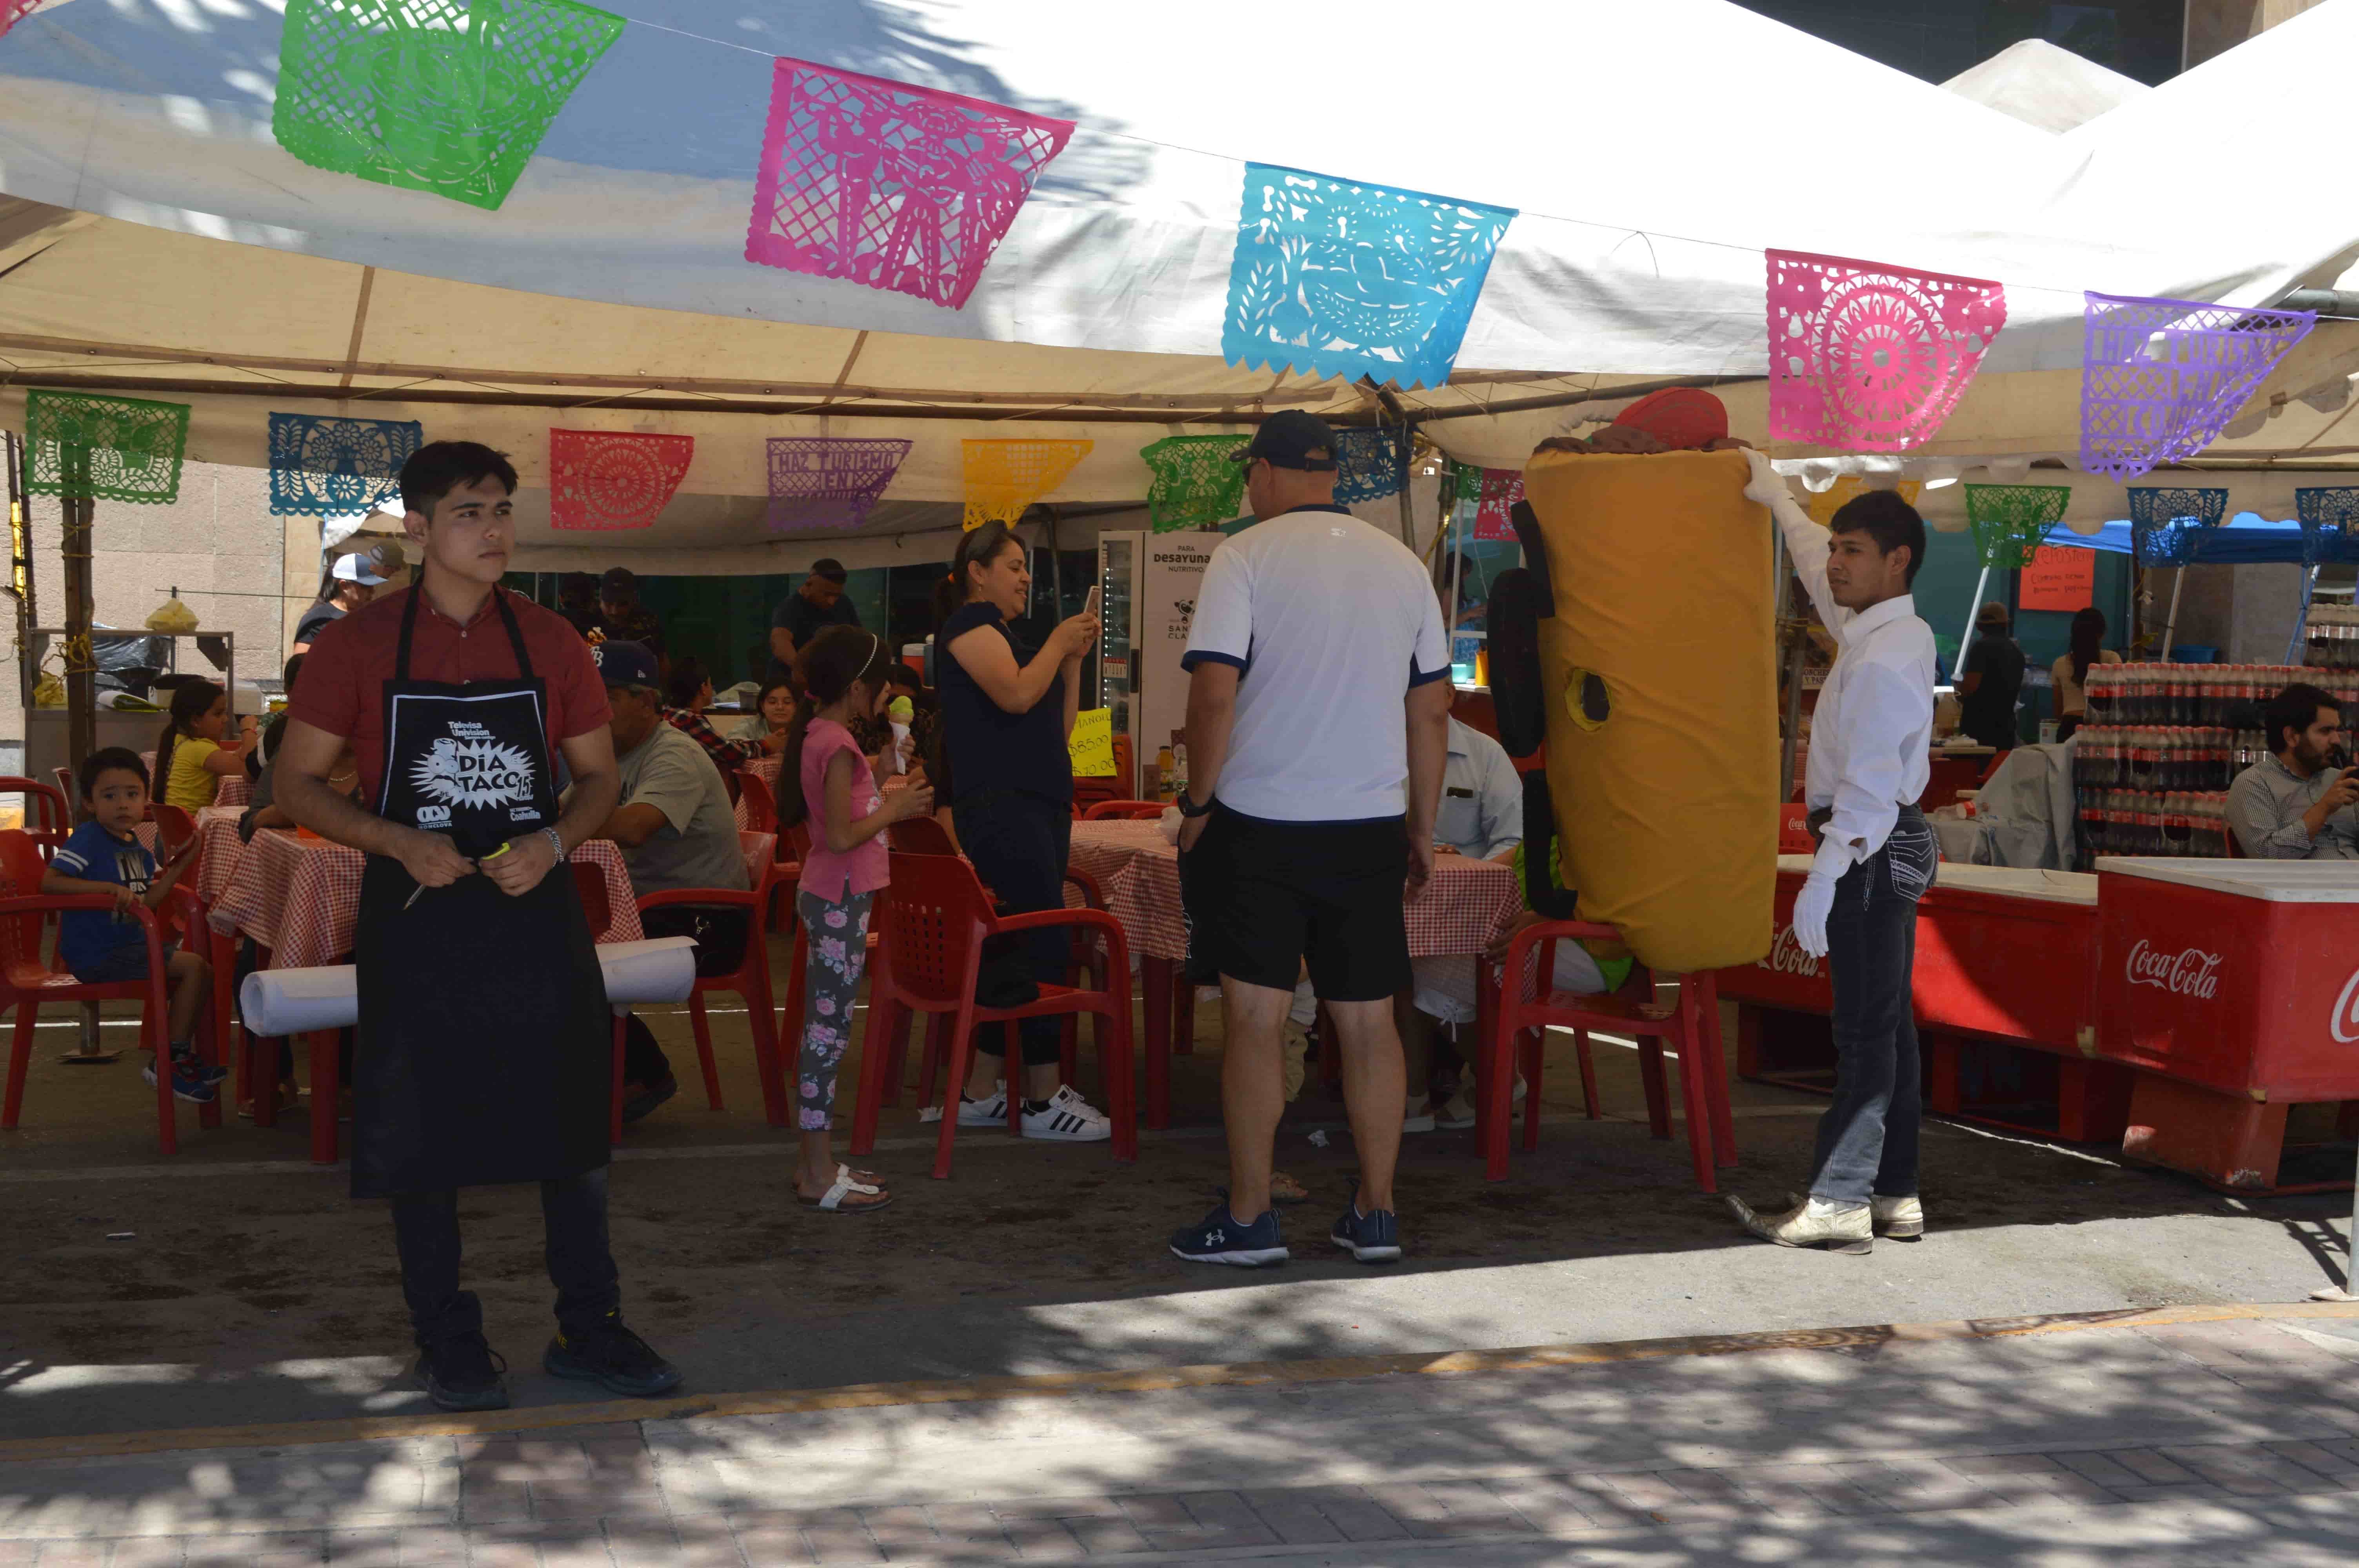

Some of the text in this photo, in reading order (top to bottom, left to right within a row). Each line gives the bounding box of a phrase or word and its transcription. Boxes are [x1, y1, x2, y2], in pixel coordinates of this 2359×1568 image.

[780, 452, 893, 472] HAZ TURISMO
[447, 721, 484, 729] Televisa
[458, 771, 520, 792] TACO
[2126, 939, 2223, 1000] Coca-Cola
